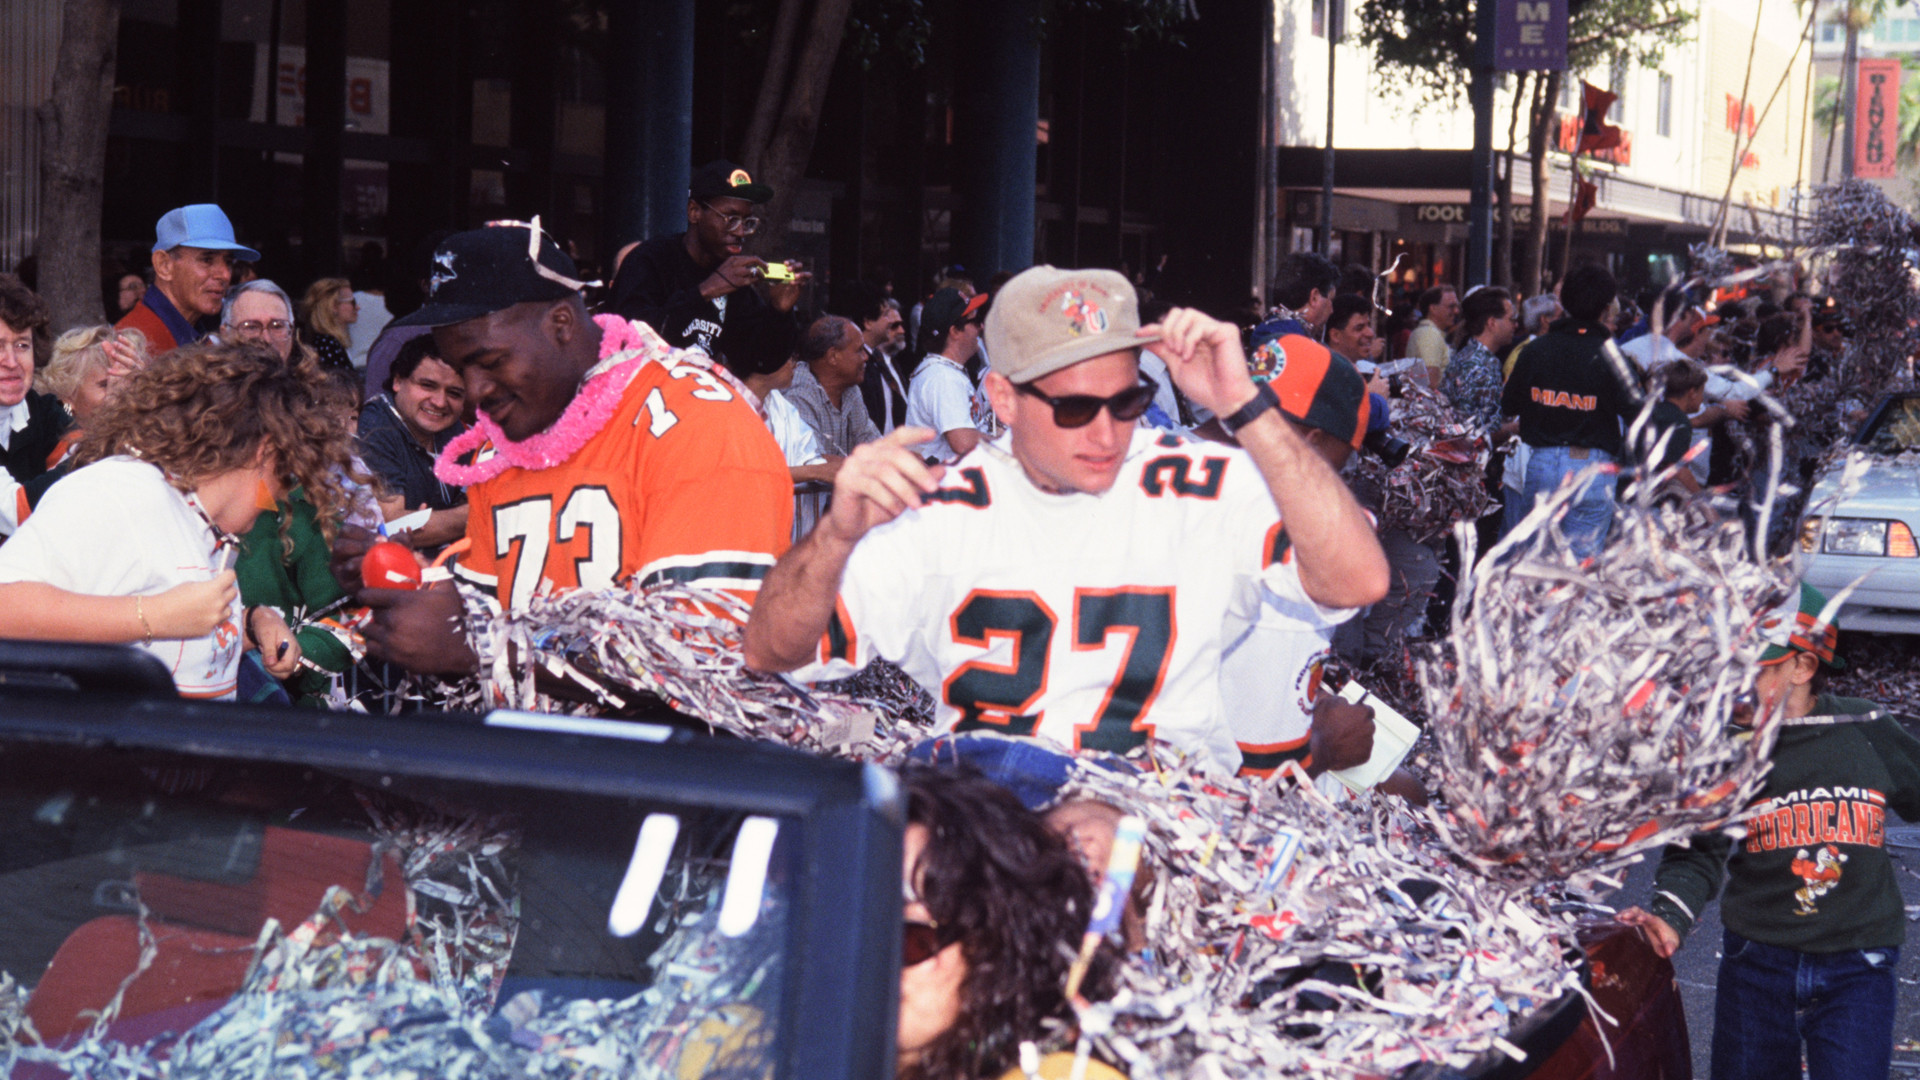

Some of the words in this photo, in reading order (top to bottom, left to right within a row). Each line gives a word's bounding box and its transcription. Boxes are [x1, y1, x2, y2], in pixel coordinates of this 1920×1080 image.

[1530, 386, 1597, 411] MIAMI
[492, 484, 623, 622] 73
[942, 585, 1178, 755] 27
[1770, 786, 1868, 807] MIAMI
